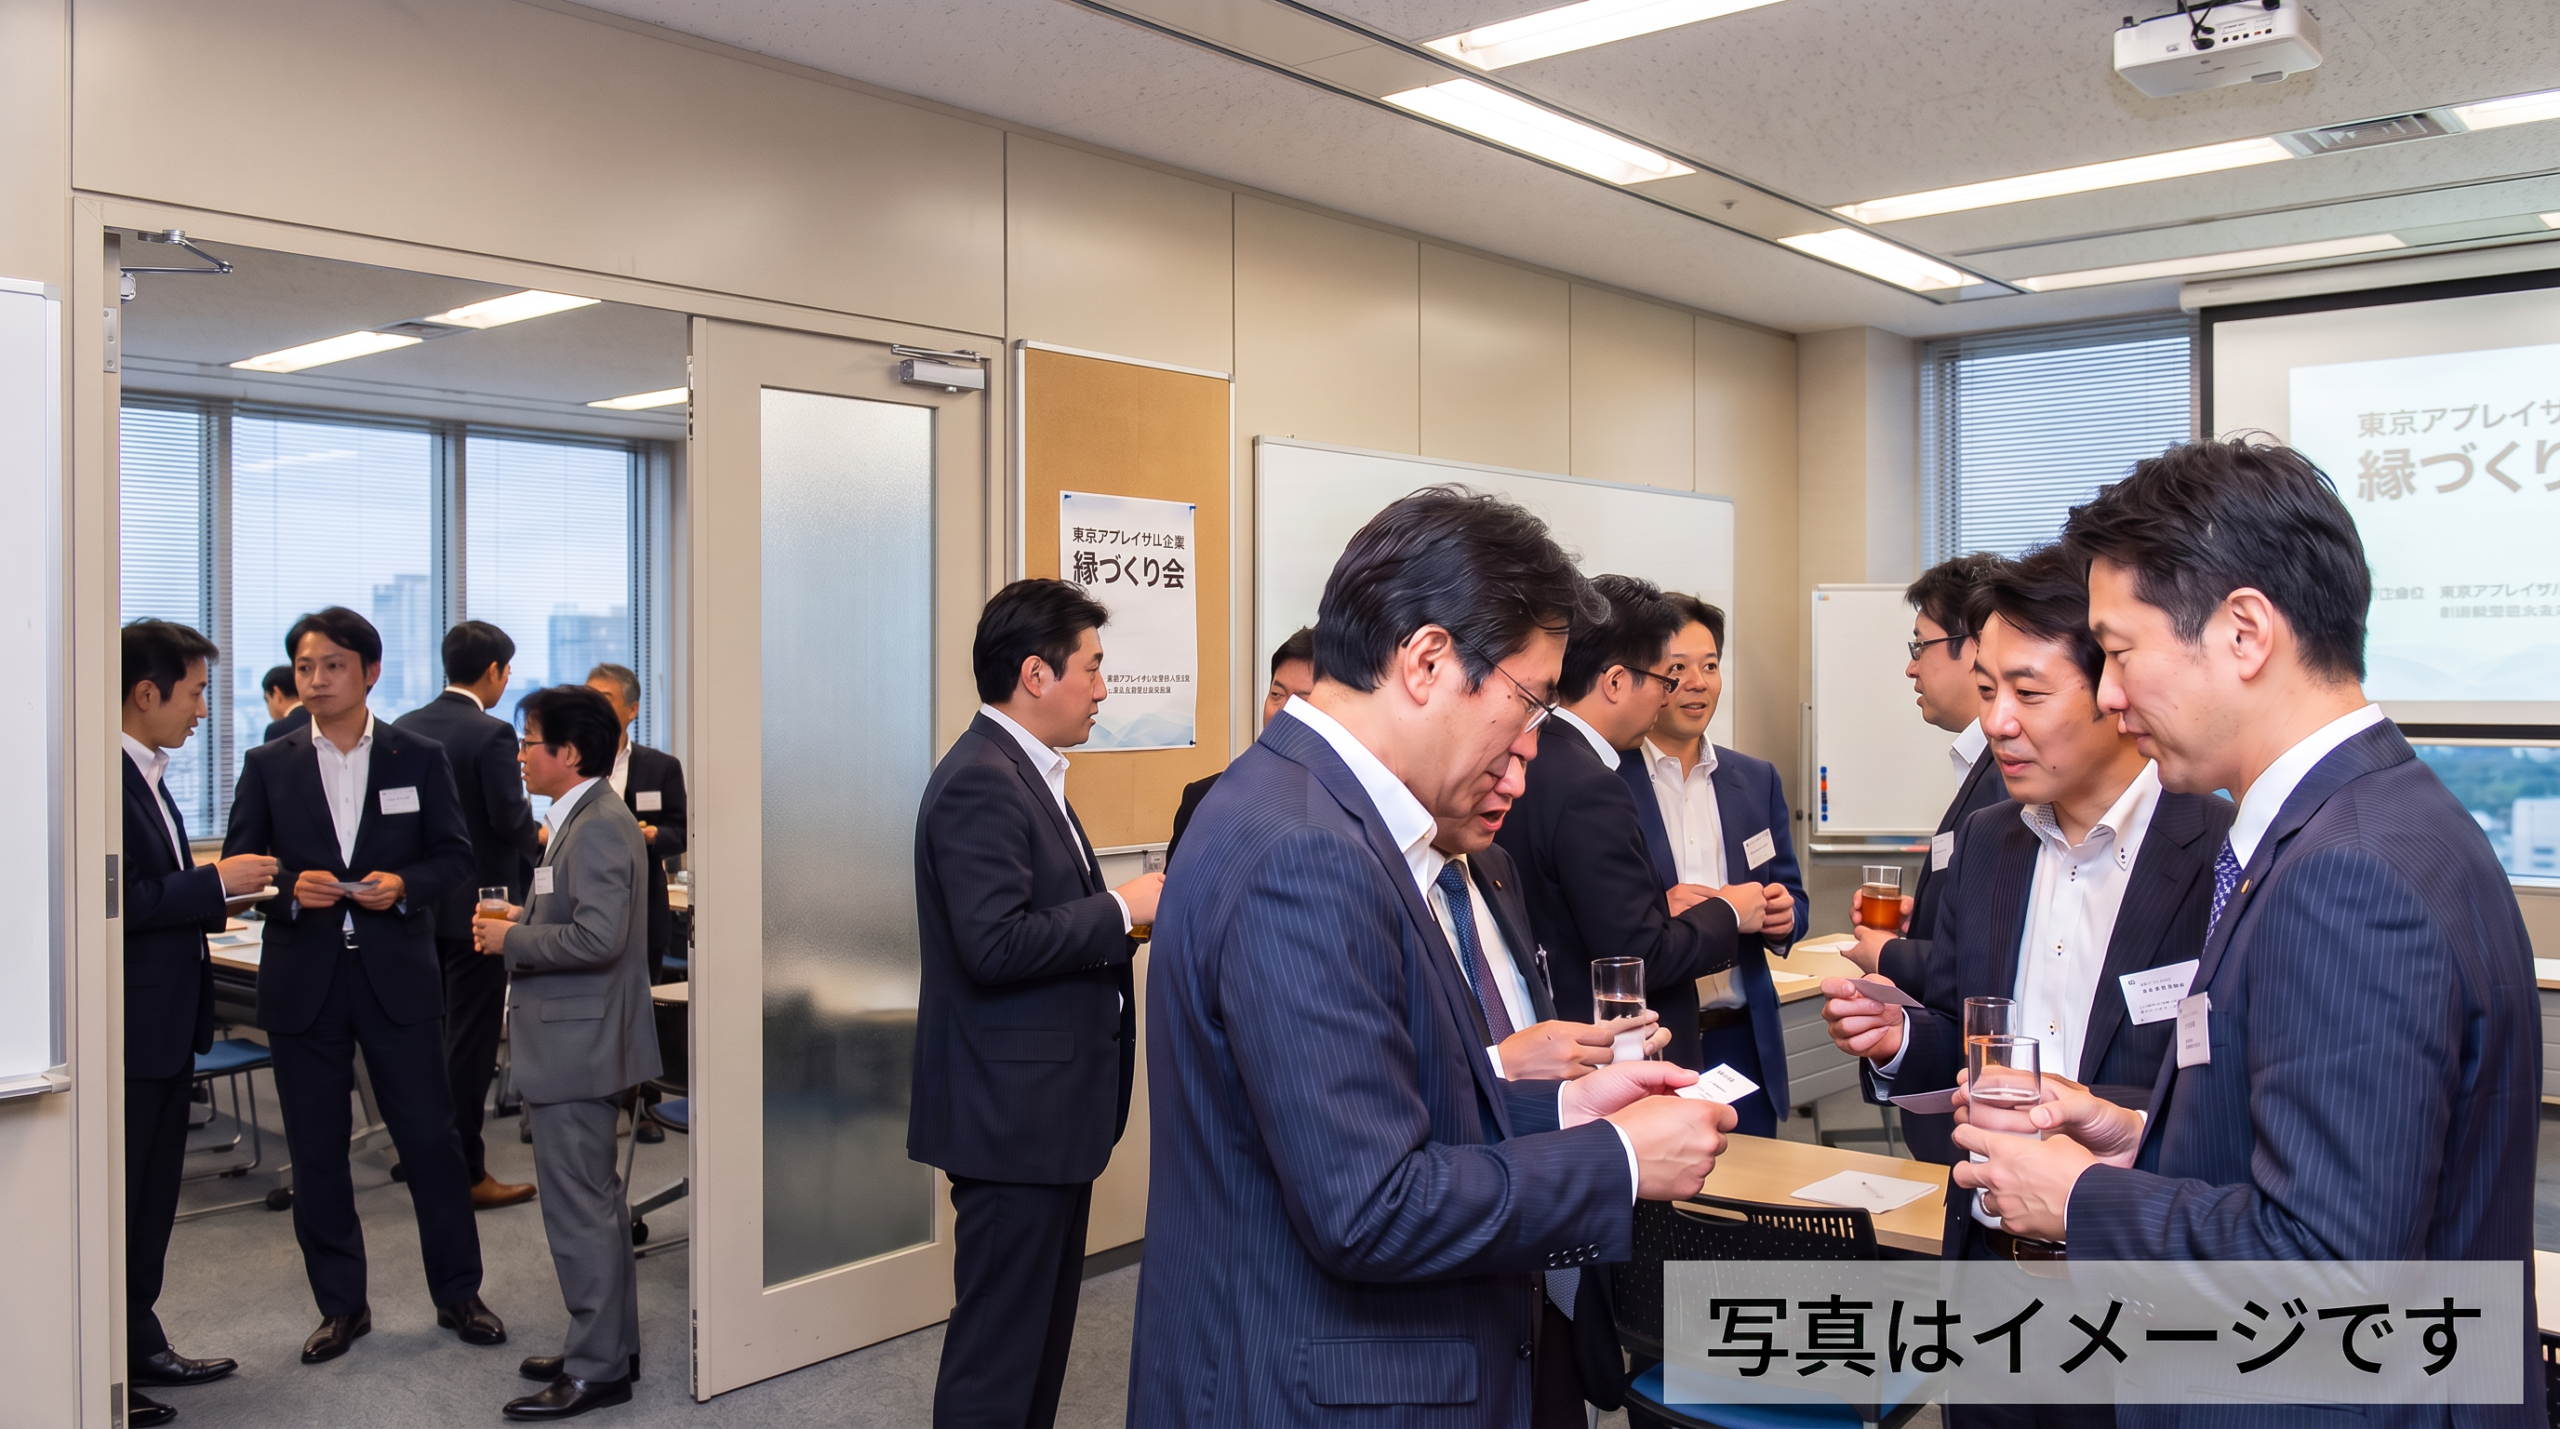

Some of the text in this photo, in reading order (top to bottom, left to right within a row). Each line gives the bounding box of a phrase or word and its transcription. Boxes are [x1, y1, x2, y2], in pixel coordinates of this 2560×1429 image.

[2358, 440, 2560, 502] 縁づくり
[1073, 550, 1185, 589] 縁づくり会
